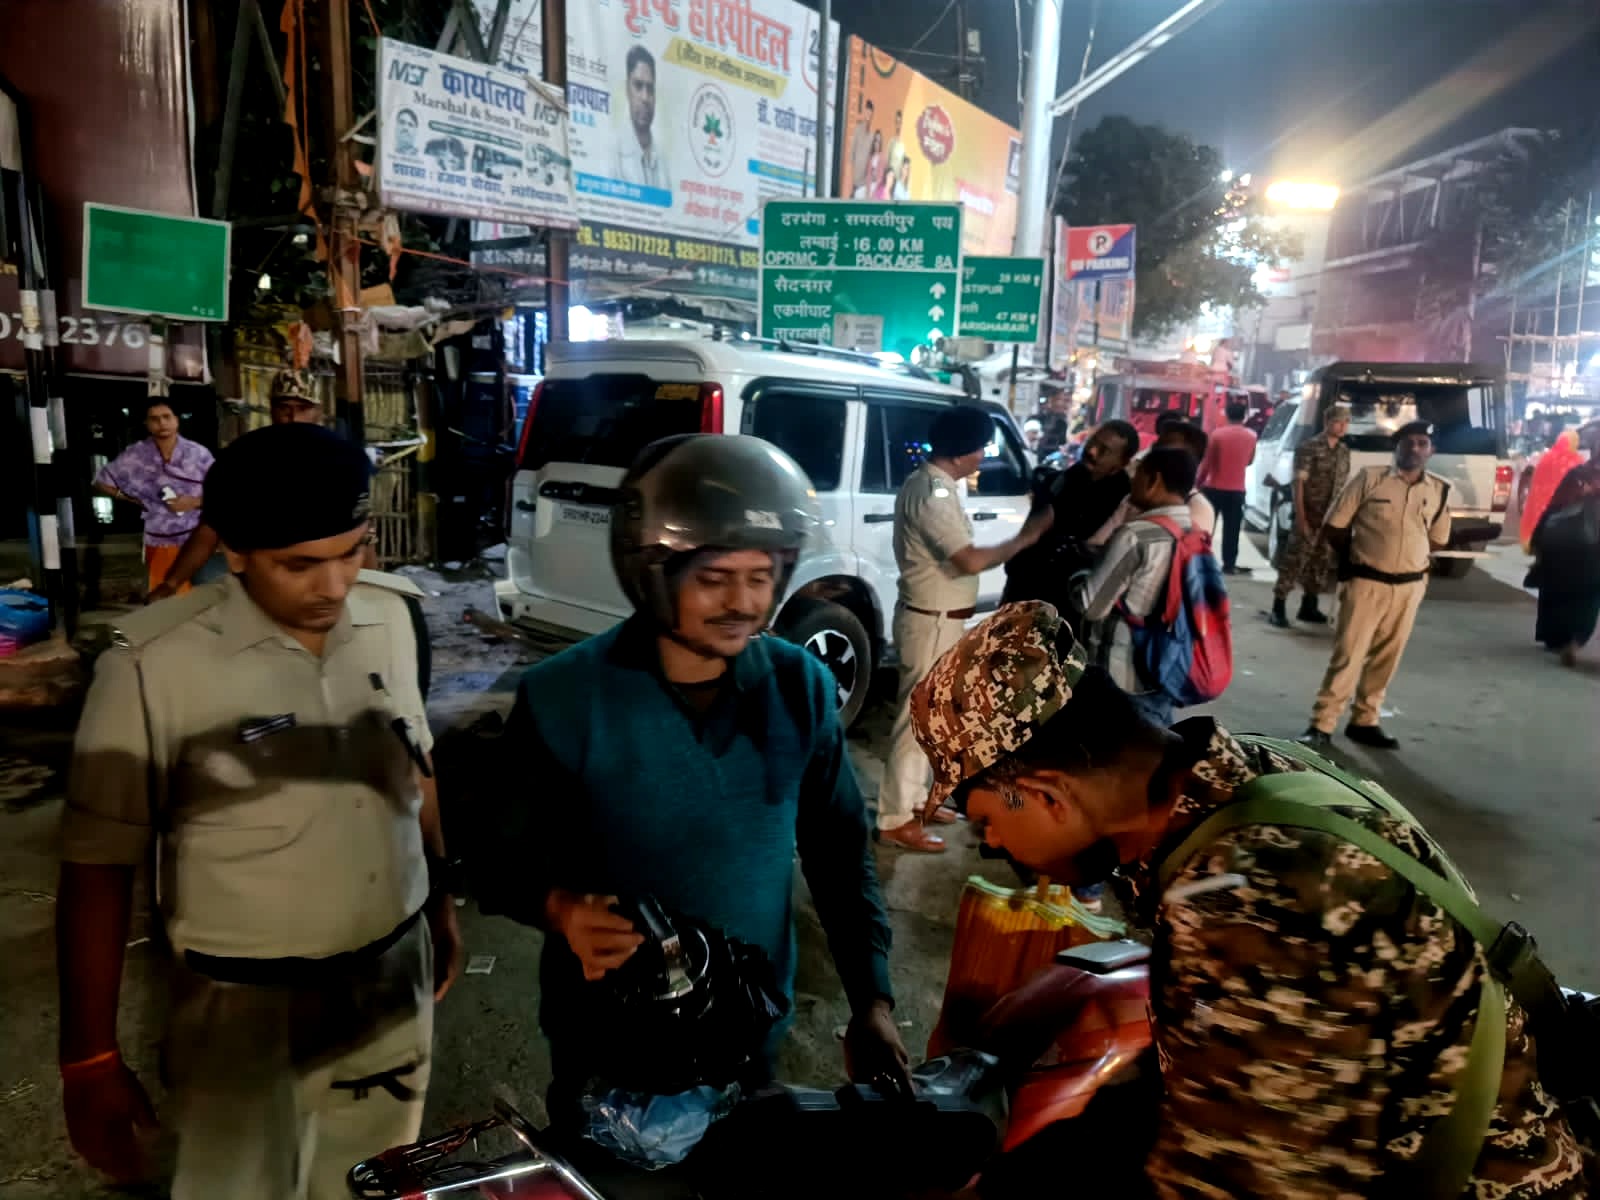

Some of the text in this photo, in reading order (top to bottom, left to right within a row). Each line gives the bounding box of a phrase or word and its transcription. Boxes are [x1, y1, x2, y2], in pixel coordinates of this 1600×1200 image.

[440, 64, 527, 115] कार्यालय
[413, 90, 467, 116] Marshal
[781, 211, 826, 227] दरभंगा
[845, 209, 915, 233] समस्तीपुर
[899, 238, 924, 253] KM
[765, 251, 818, 267] OPRMC
[855, 253, 924, 268] PACKAGE
